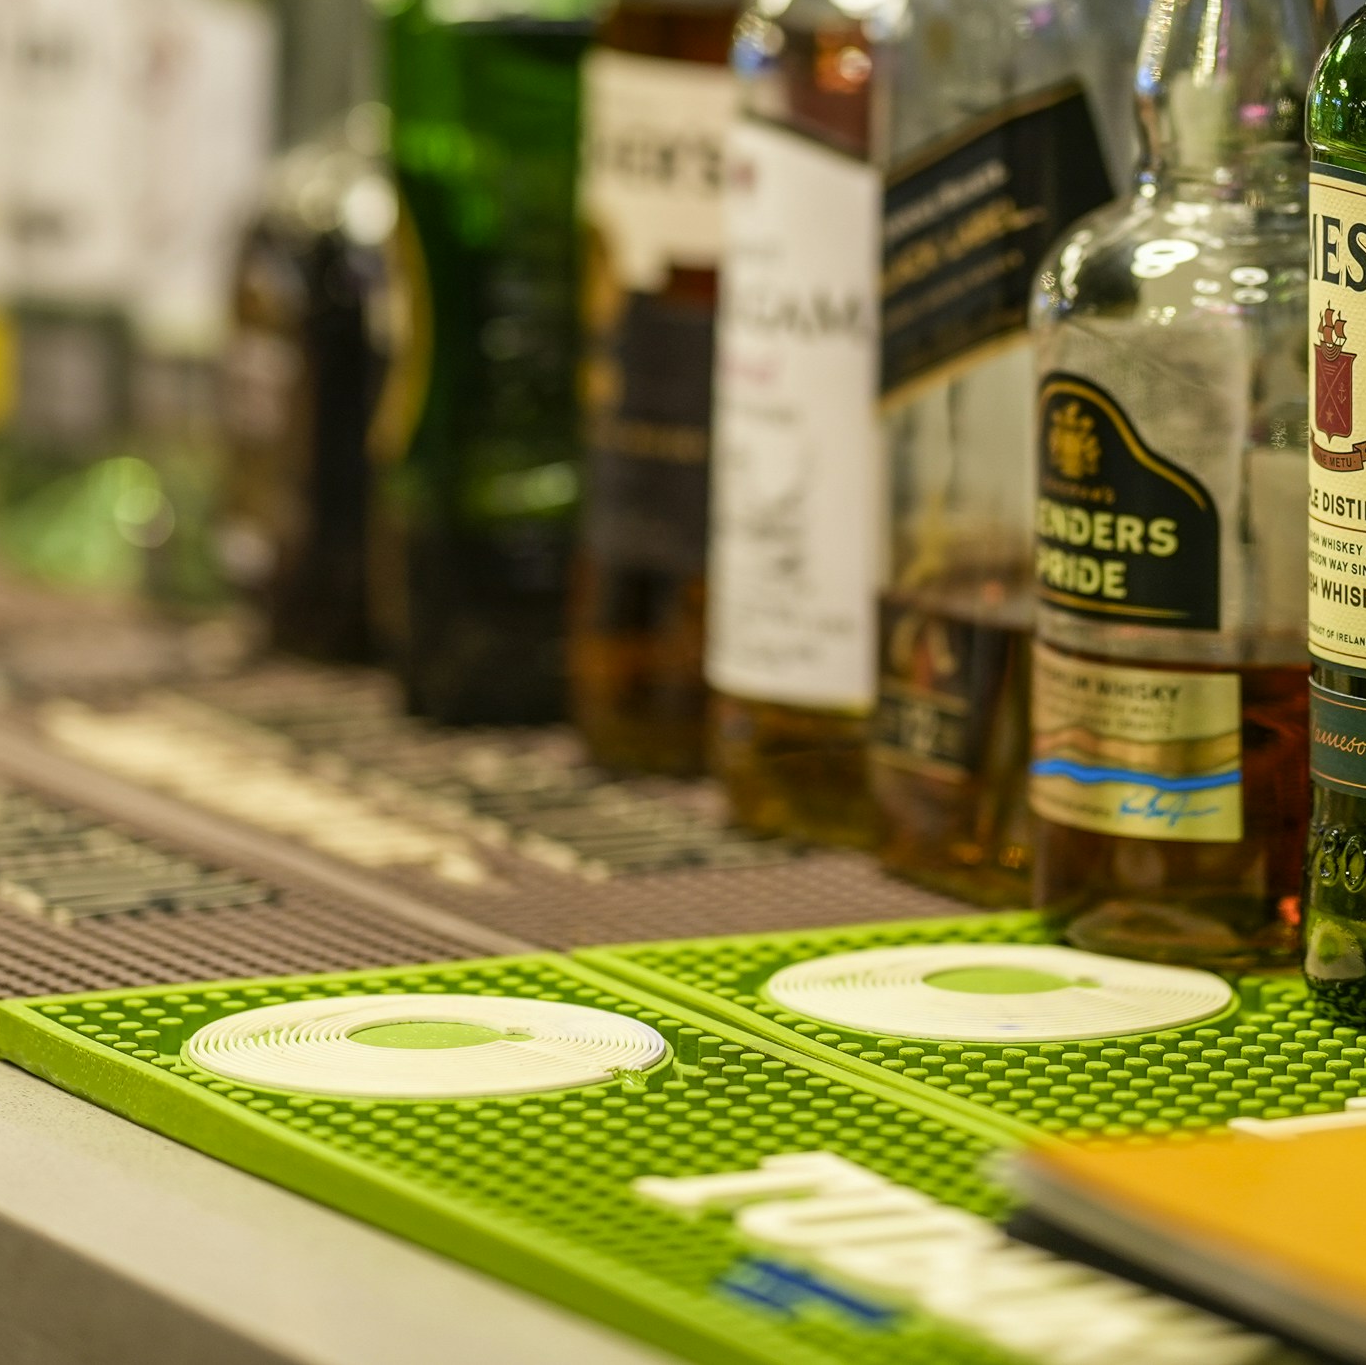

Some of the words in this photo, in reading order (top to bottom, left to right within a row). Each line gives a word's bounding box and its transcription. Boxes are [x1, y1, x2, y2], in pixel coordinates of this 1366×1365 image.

[1330, 457, 1352, 468] METU
[1321, 535, 1363, 556] WHISKEY
[1328, 557, 1349, 573] WAY
[1326, 629, 1335, 639] OF
